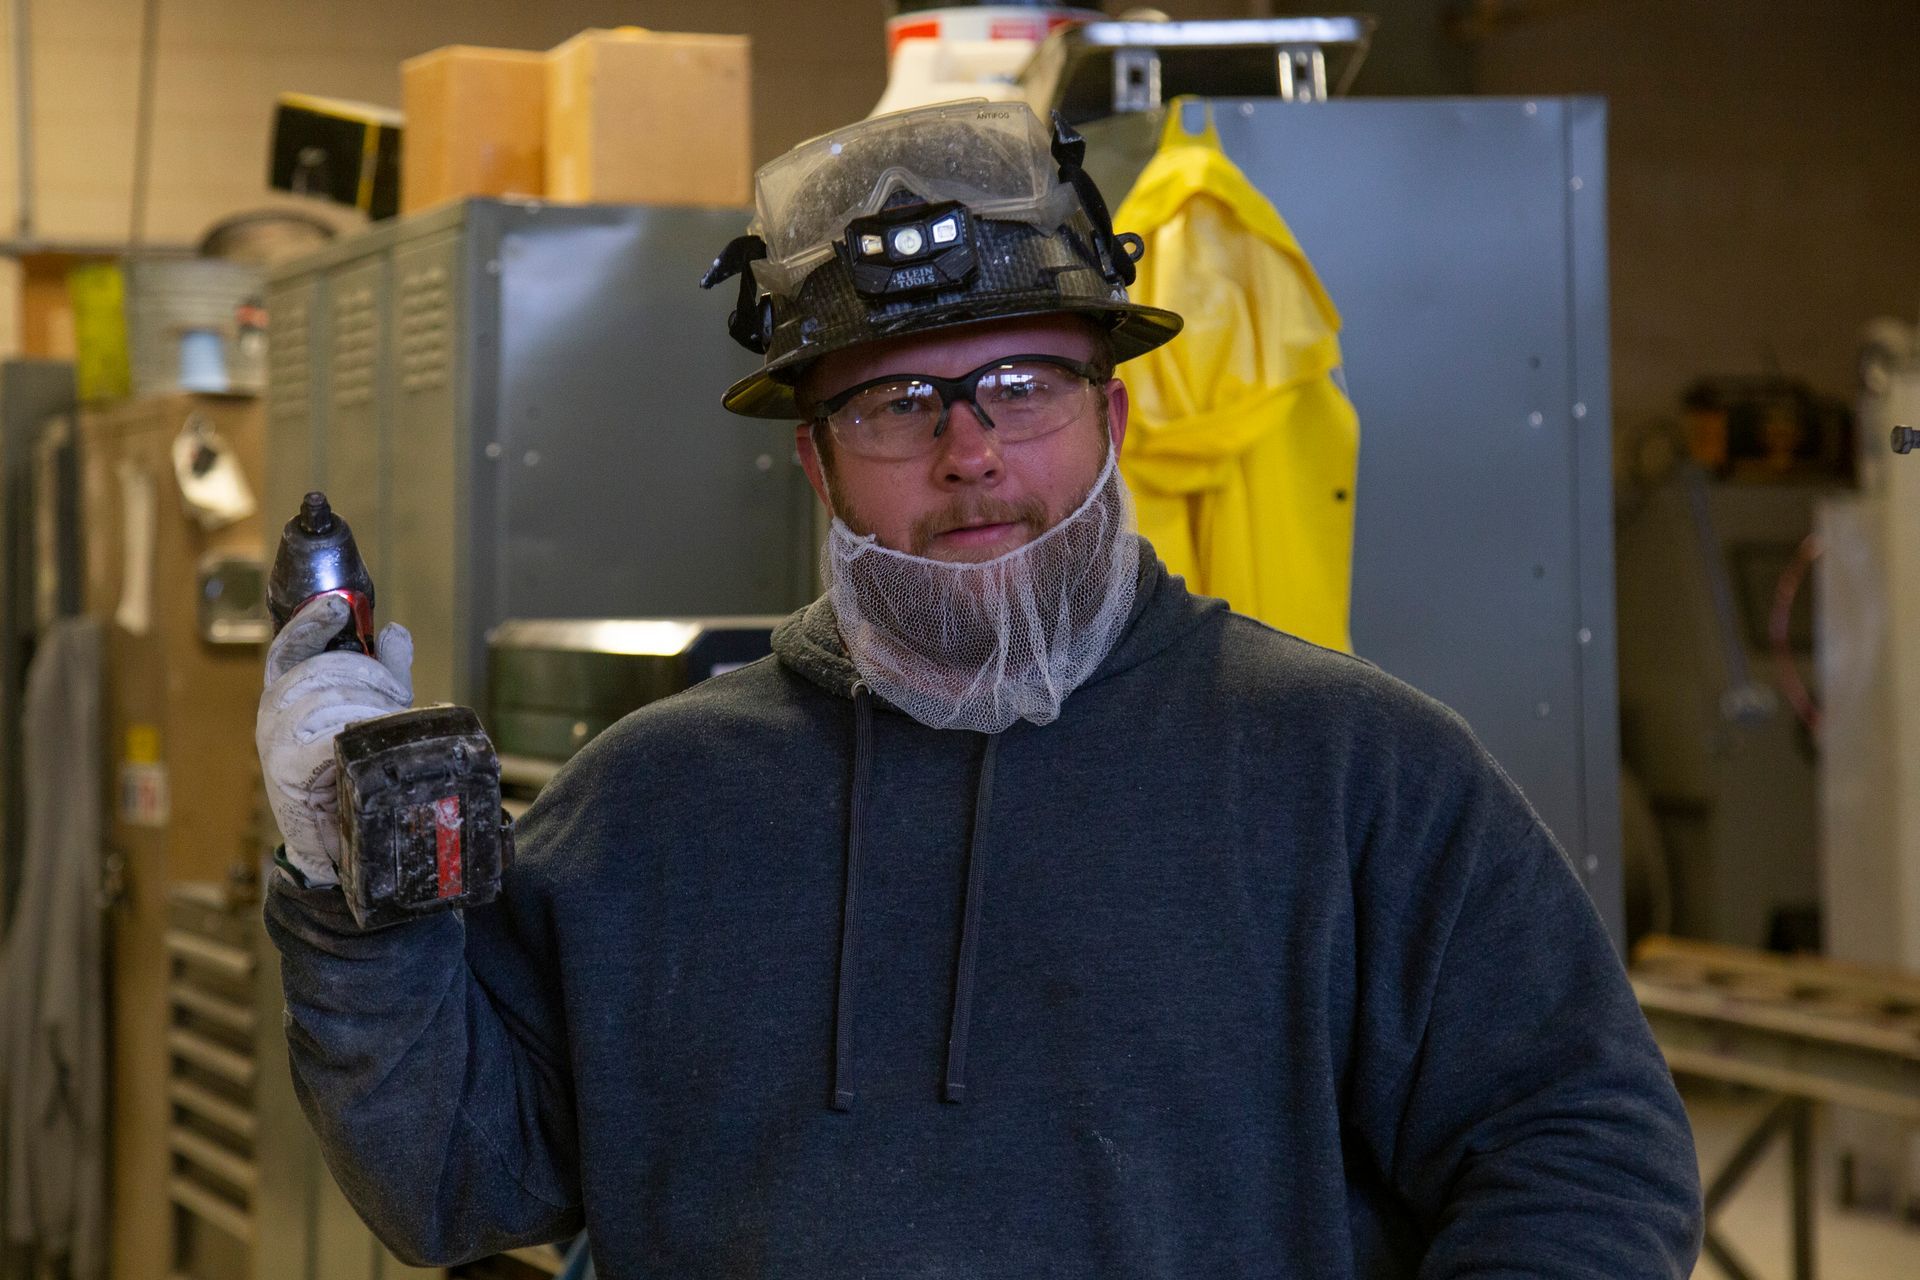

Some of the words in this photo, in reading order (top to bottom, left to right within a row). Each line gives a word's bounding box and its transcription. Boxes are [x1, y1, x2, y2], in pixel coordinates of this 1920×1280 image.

[976, 111, 1010, 120] ANTIFOG
[896, 266, 933, 281] KLEIN
[897, 274, 936, 289] TOOLS
